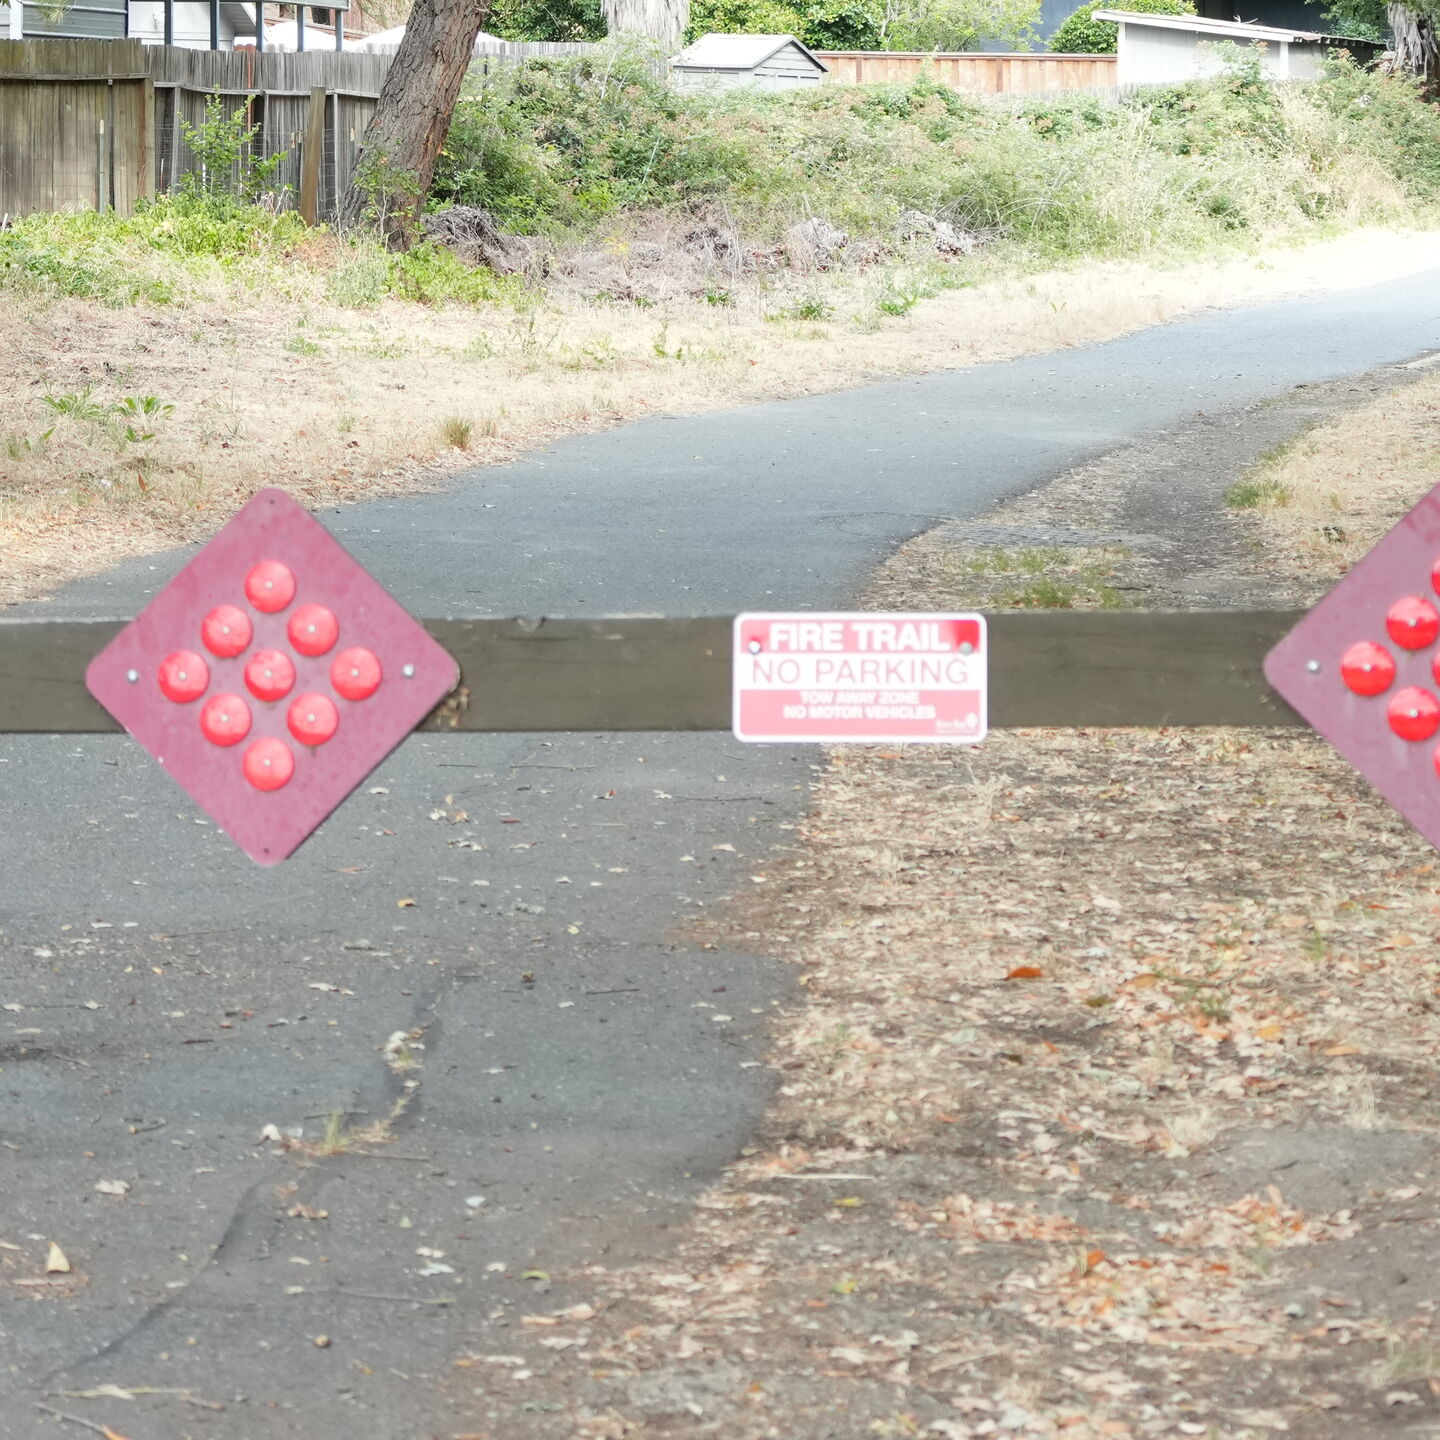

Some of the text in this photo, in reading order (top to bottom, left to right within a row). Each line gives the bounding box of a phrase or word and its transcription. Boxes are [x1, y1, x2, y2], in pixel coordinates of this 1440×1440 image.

[769, 623, 951, 651] FIRE TRAIL
[753, 659, 968, 684] NO PARKING
[800, 691, 920, 704] TOW AWAY ZONE
[783, 705, 936, 719] NO MOTOR VEHICLES
